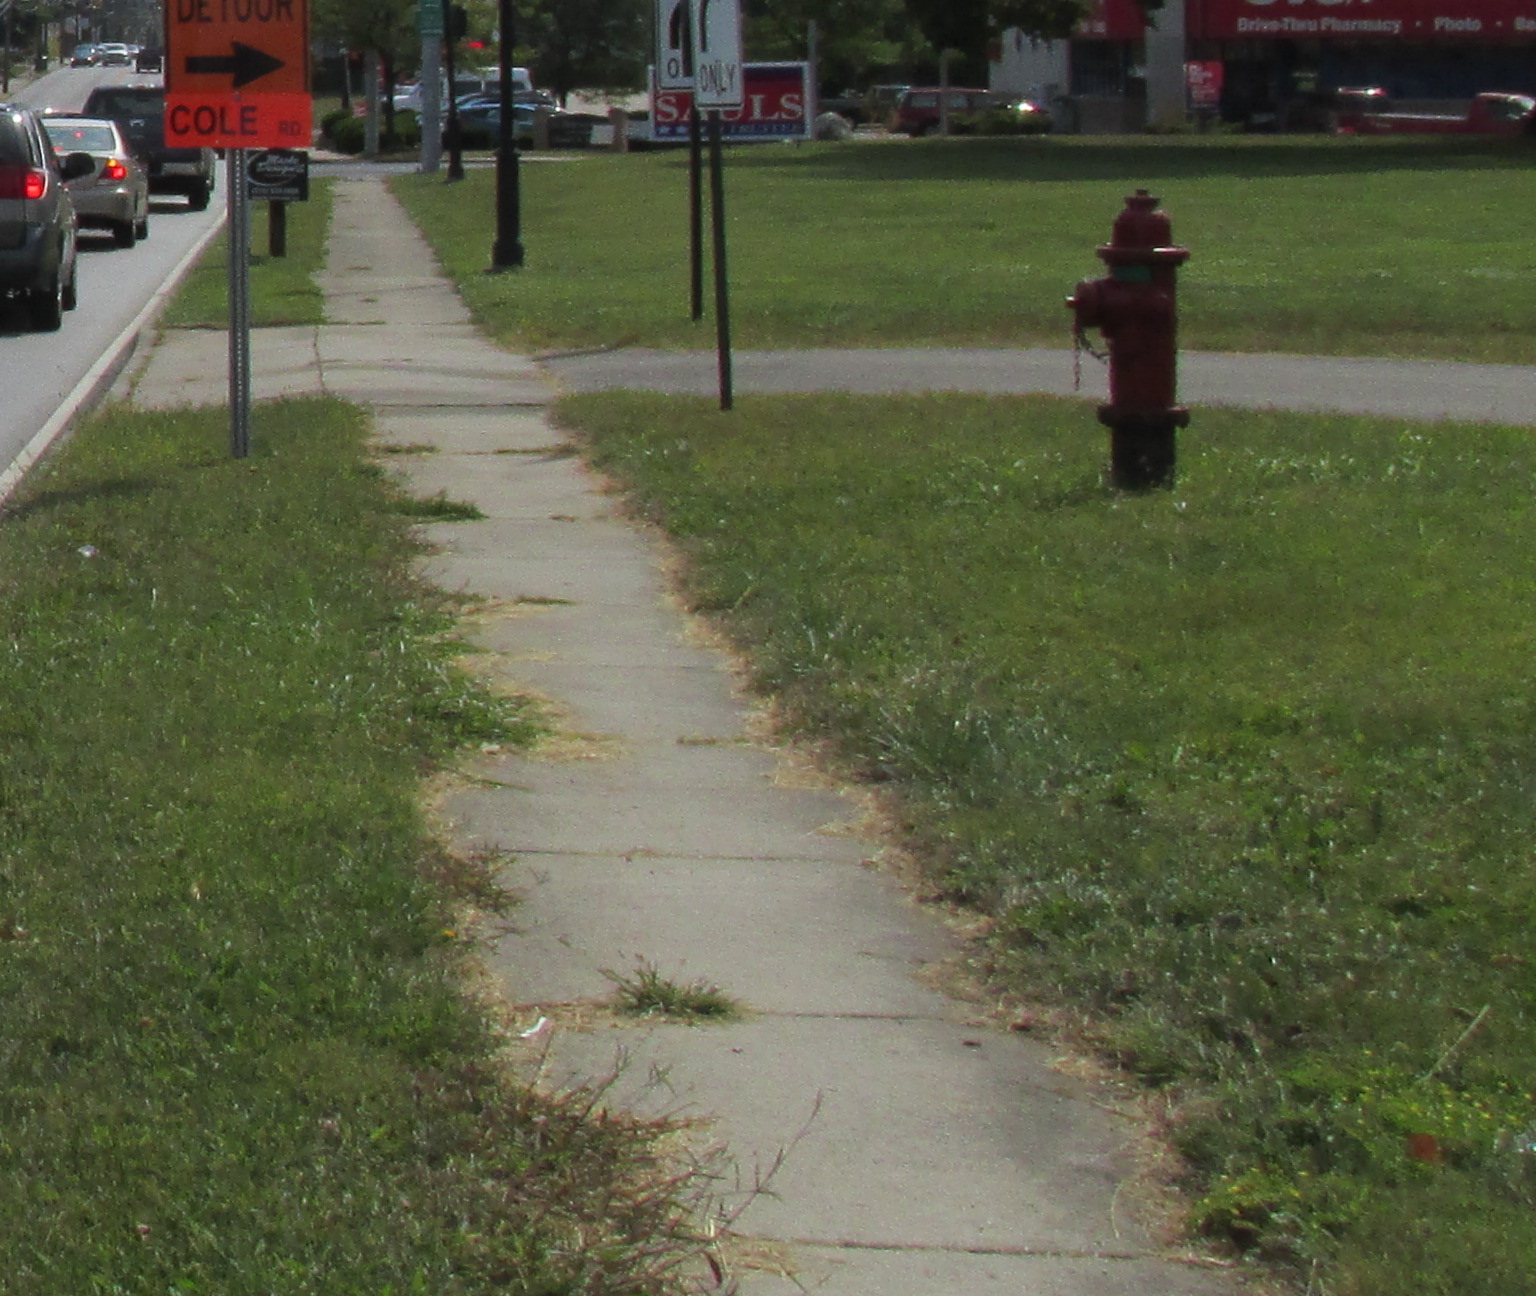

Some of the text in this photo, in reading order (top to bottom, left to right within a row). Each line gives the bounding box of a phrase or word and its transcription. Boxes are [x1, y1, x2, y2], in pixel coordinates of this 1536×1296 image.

[1434, 16, 1482, 32] Photo
[700, 63, 735, 92] ONLY
[170, 105, 302, 136] COLE RD
[656, 93, 804, 123] SLS
